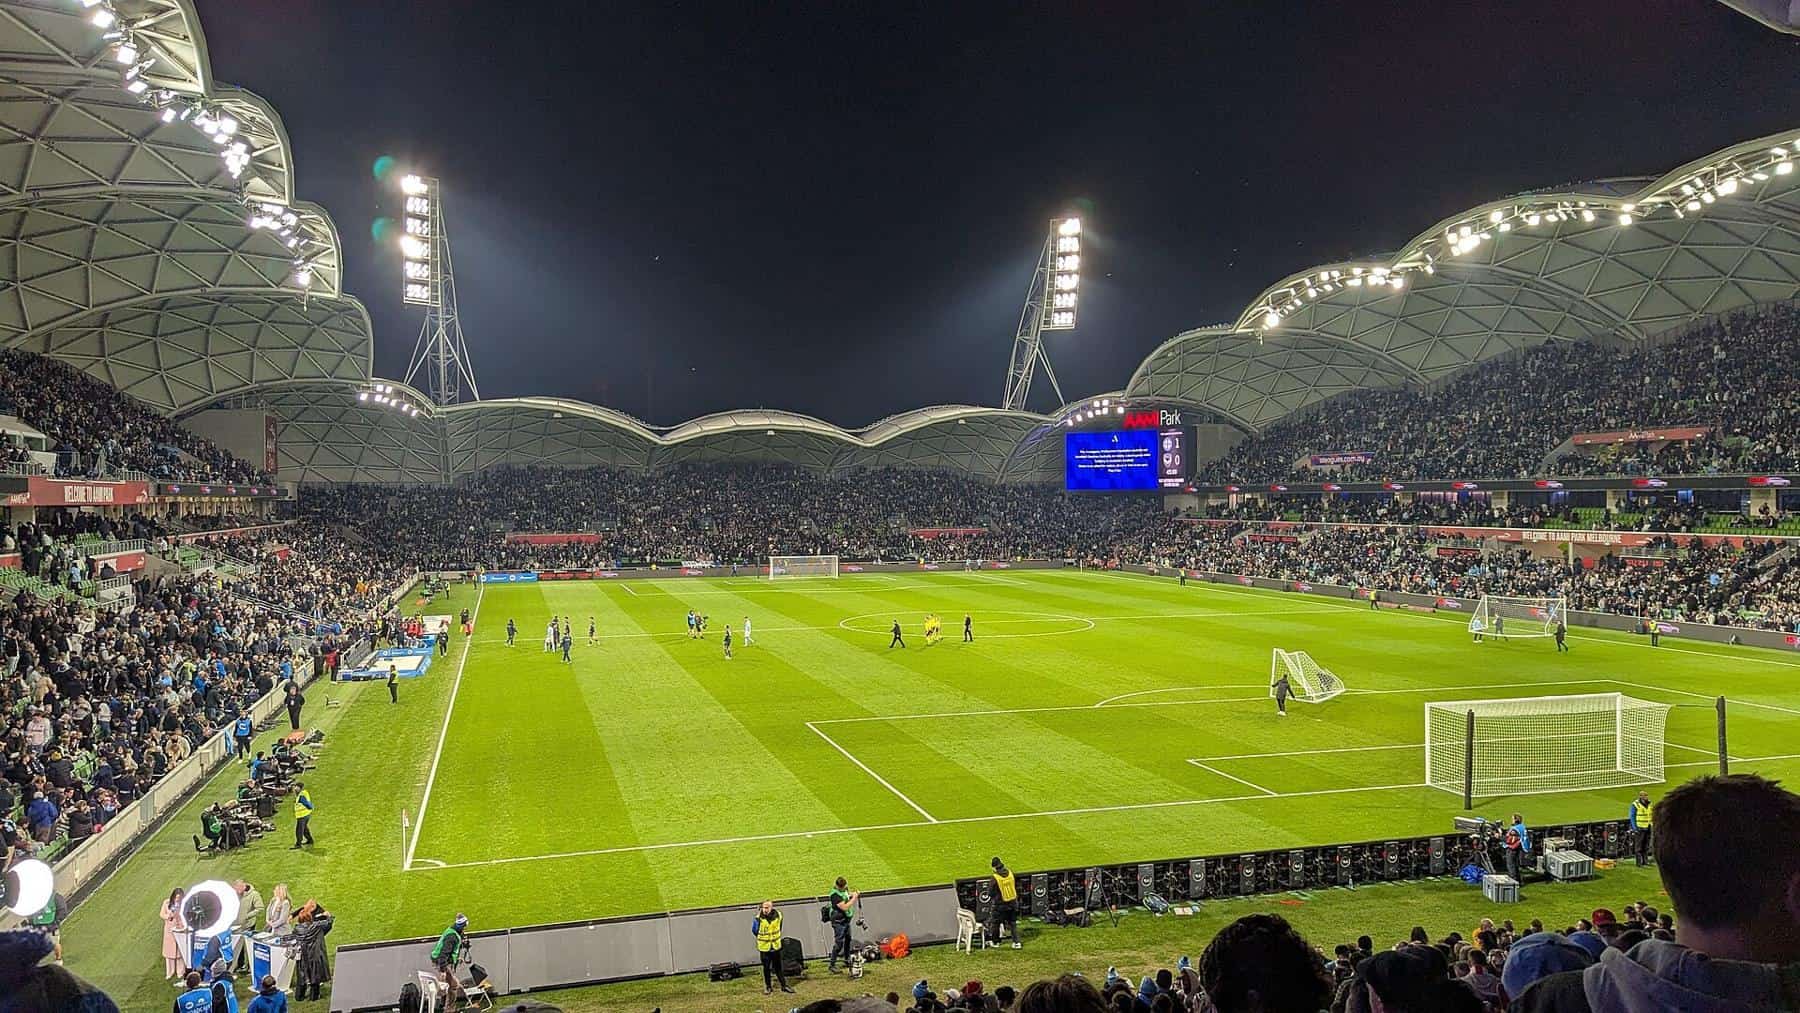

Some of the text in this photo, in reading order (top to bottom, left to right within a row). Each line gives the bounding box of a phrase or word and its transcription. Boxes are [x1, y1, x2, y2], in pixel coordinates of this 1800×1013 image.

[1160, 409, 1181, 426] Park
[1175, 437, 1180, 448] 1
[1174, 454, 1180, 466] 0
